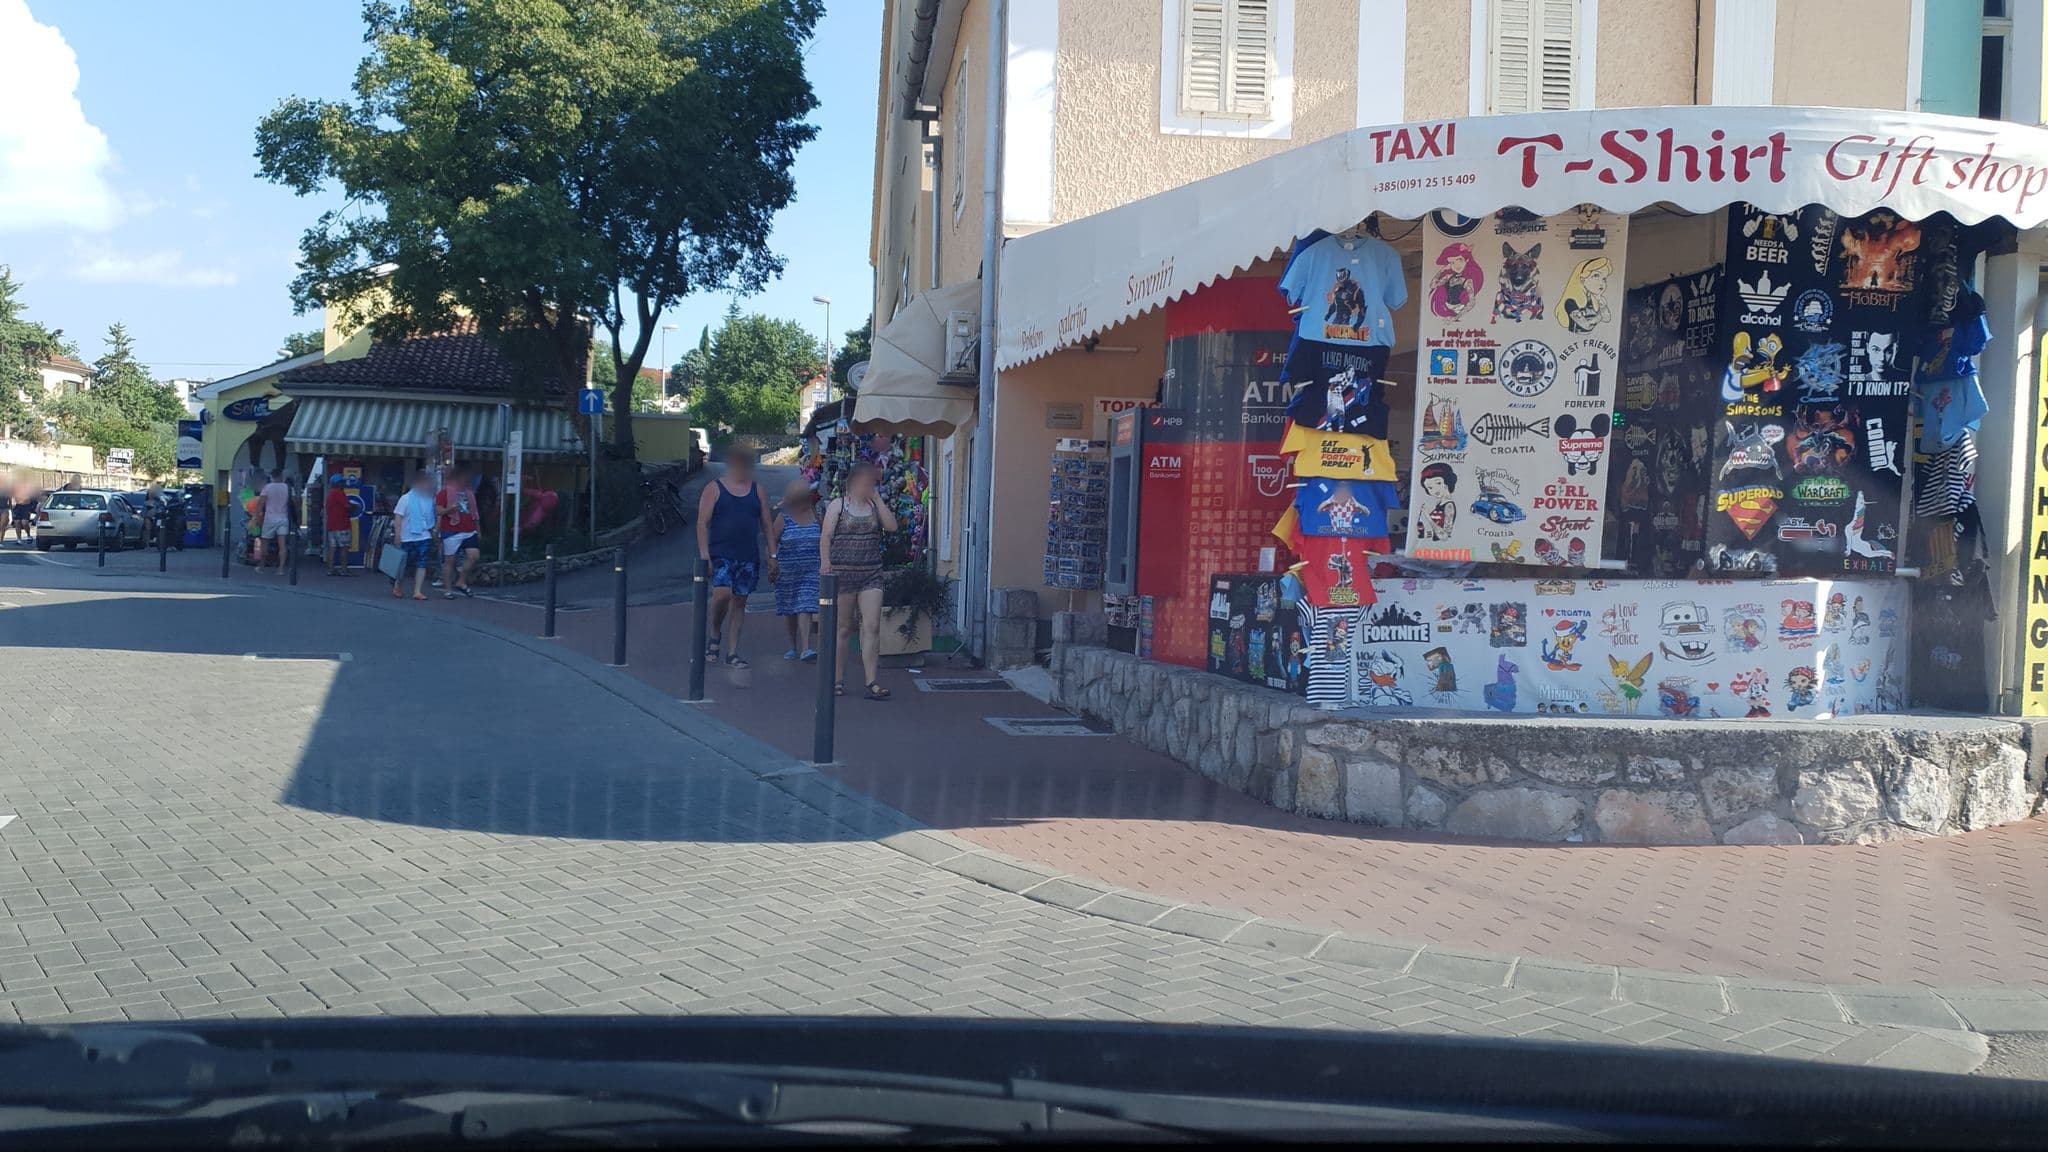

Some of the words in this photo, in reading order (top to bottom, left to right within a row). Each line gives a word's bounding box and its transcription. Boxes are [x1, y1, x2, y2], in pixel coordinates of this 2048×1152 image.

[1369, 122, 1456, 164] TAXI
[1497, 127, 1792, 189] T-Shirt
[1825, 134, 1940, 203] Gift
[1945, 142, 2048, 214] shop
[1372, 178, 1422, 194] +385(0)91
[1424, 177, 1438, 189] 25
[1440, 175, 1453, 188] 15
[1455, 173, 1476, 186] 409
[1754, 239, 1777, 248] NEEDS
[1746, 246, 1789, 264] BEER
[1126, 255, 1175, 305] Suveniri
[1740, 314, 1782, 326] alcohol
[1559, 342, 1579, 361] BEST
[1583, 339, 1617, 360] FRIENDS
[1242, 381, 1297, 403] ATM
[1865, 382, 1891, 396] KNOW
[1894, 382, 1910, 396] IT?
[1564, 400, 1606, 408] FOREVER
[1743, 393, 1759, 403] THE
[1726, 403, 1782, 416] SIMPSONS
[1163, 417, 1183, 426] HPB
[1491, 446, 1536, 455] CROATIA
[1560, 440, 1603, 453] Supreme
[1321, 454, 1361, 463] FORTNITE
[1417, 444, 1468, 464] Summer
[1150, 456, 1181, 468] ATM
[1149, 471, 1181, 479] Bankomat
[1533, 498, 1598, 511] POWER
[1716, 486, 1784, 512] SUPERDAD
[1477, 528, 1514, 537] Croatia
[1844, 559, 1893, 572] EXHALE
[1555, 609, 1592, 618] CROATIA
[1619, 603, 1639, 618] LOVE
[1364, 624, 1430, 642] FORTNITE
[1357, 651, 1376, 661] HOW
